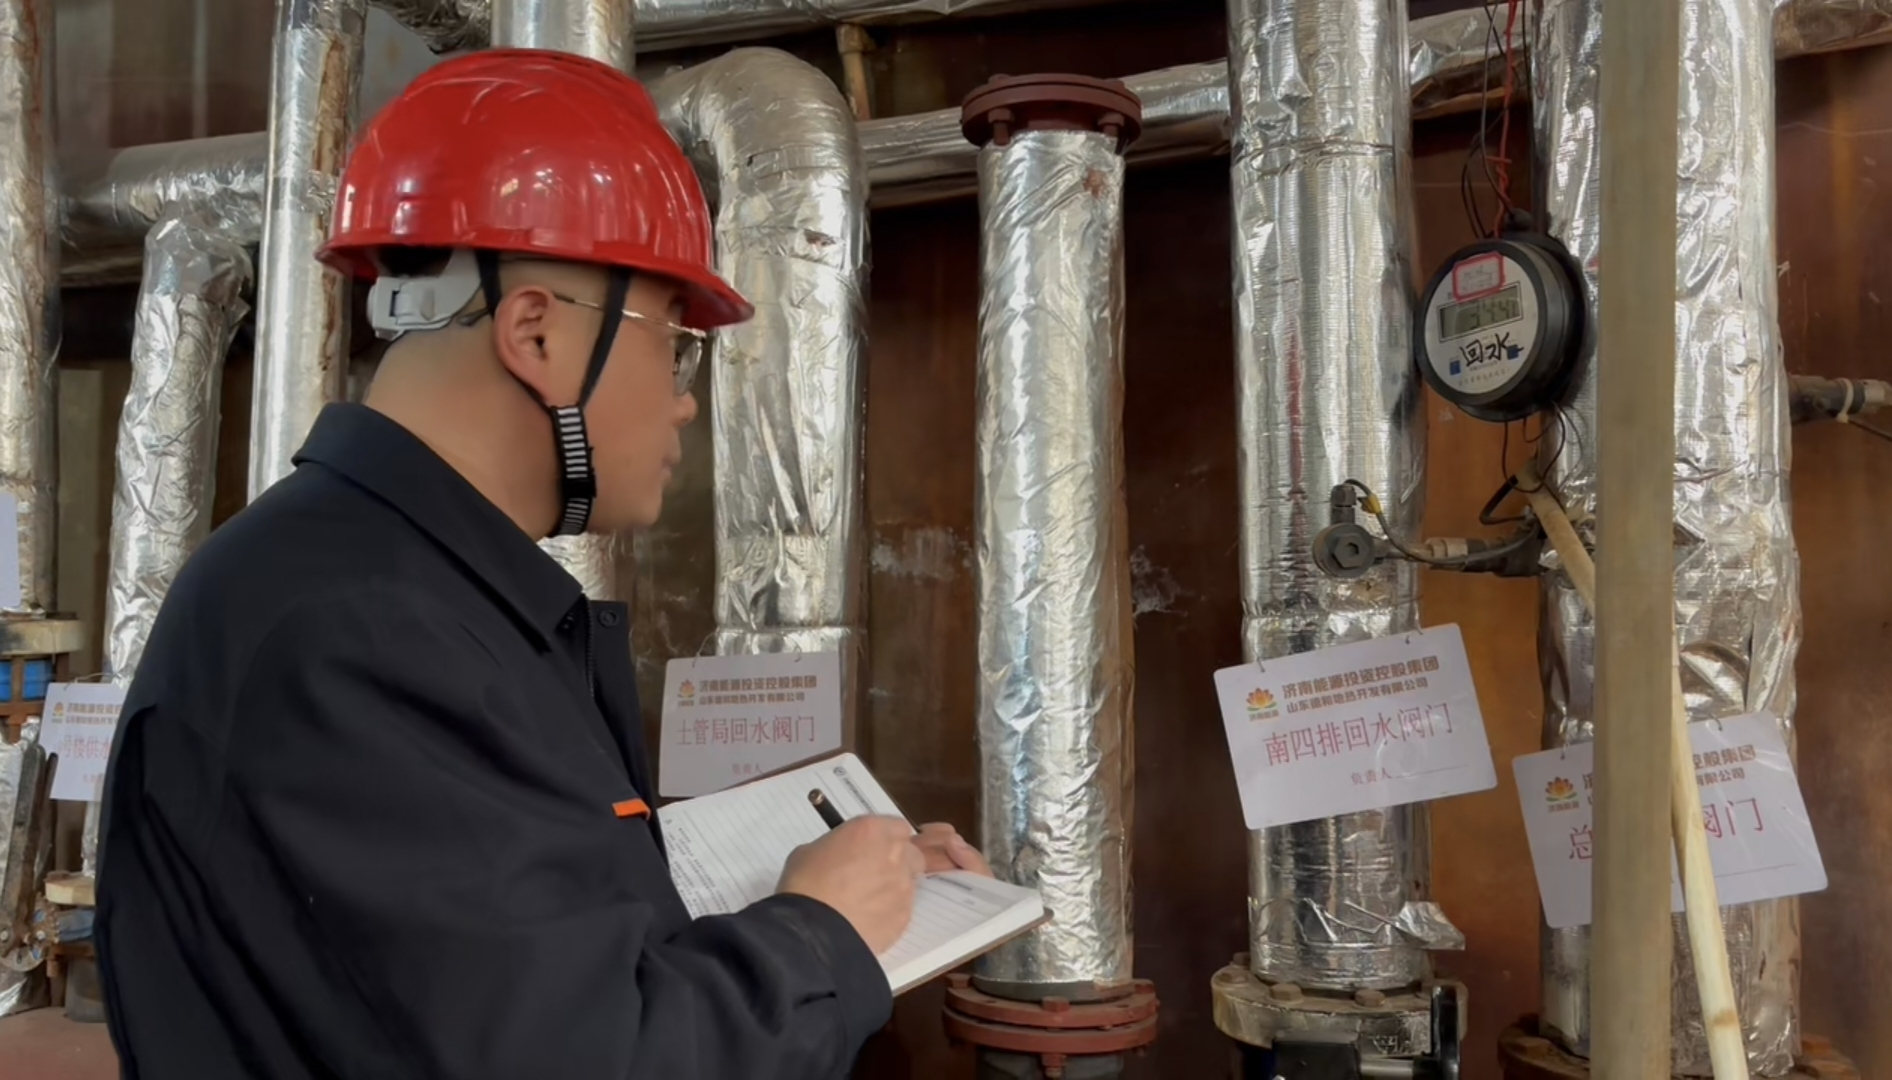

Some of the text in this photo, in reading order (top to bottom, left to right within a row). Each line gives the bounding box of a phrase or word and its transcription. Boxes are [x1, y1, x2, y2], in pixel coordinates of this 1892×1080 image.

[1459, 332, 1525, 367] 回水
[699, 675, 817, 693] 济南能源投资控股集团
[1282, 655, 1440, 699] 济南能源投资控股集团
[1286, 677, 1429, 714] 山东德和地热开发有限公司
[1263, 702, 1453, 766] 南四排回水阀门
[1351, 766, 1393, 785] 负责人
